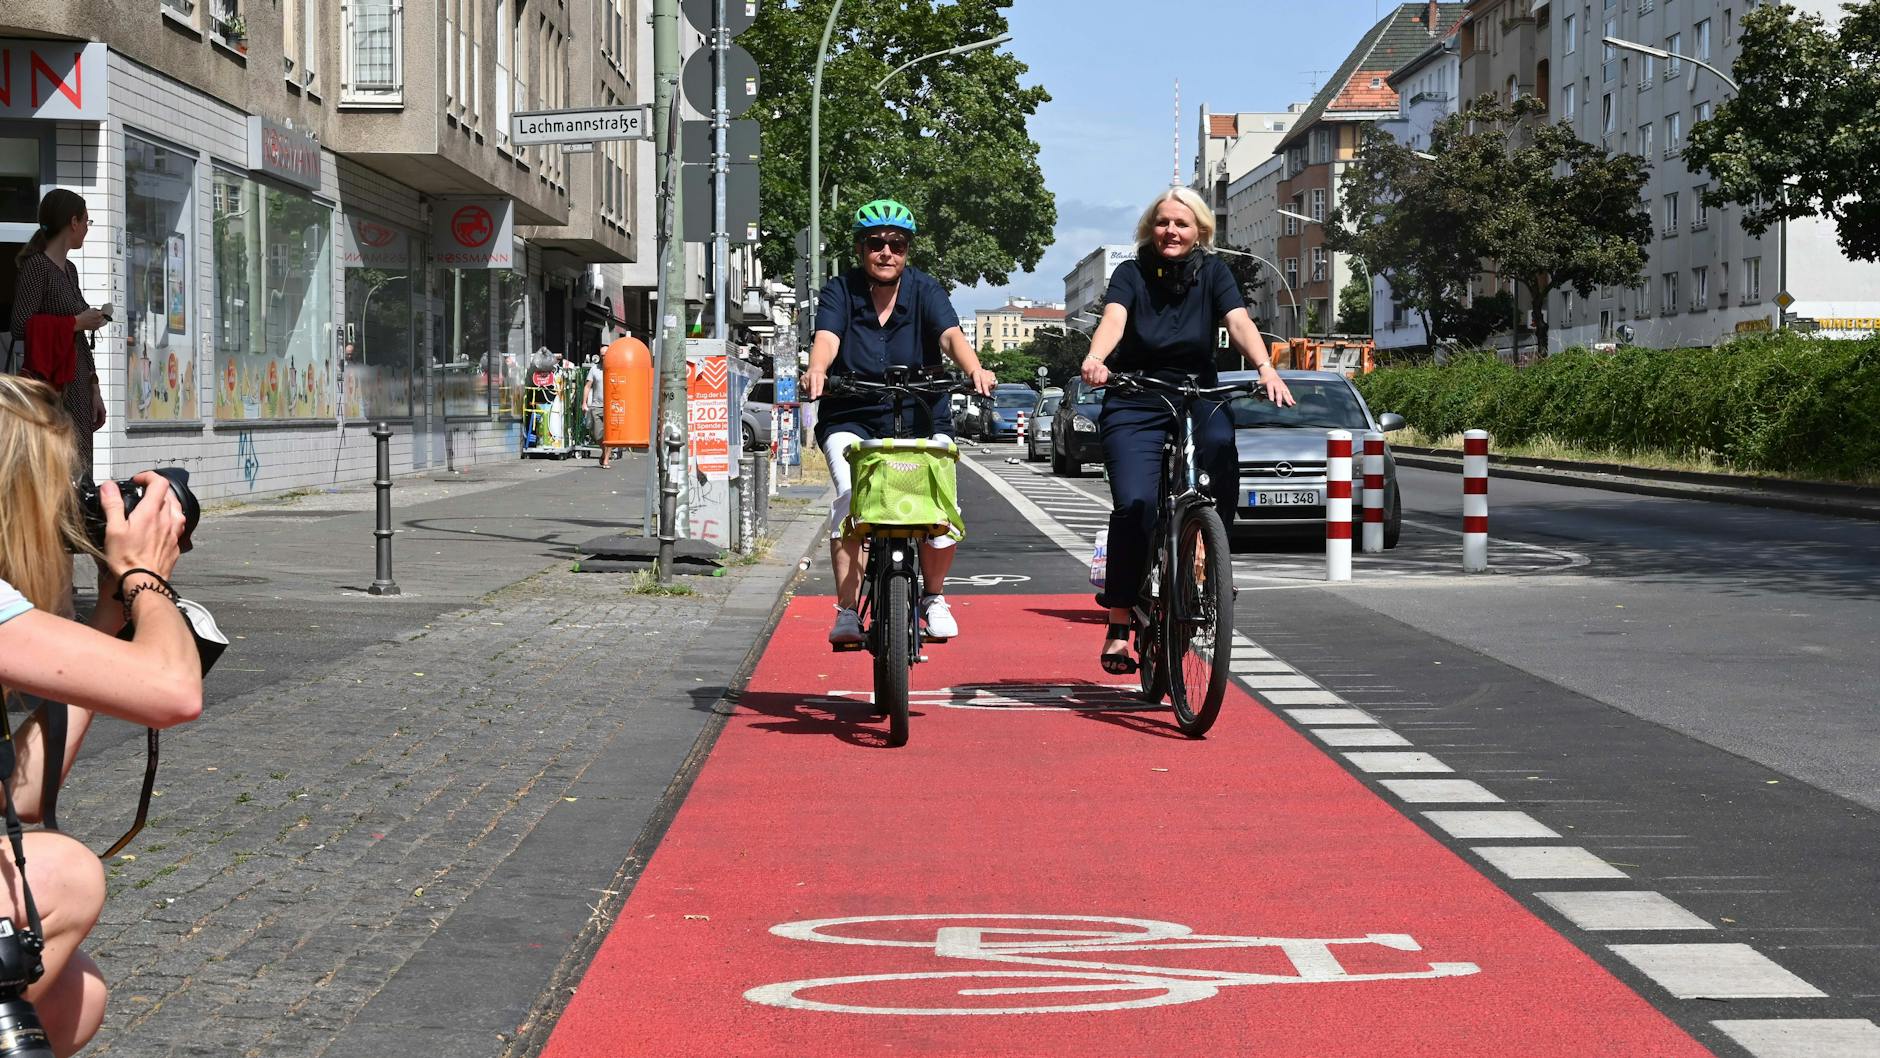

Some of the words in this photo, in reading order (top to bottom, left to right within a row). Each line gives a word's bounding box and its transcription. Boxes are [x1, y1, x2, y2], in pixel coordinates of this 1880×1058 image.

[0, 48, 81, 109] N
[520, 114, 638, 134] Lachmannstraße
[437, 252, 508, 264] ROSSMANN
[1260, 493, 1267, 504] B
[1275, 493, 1289, 504] UI
[1292, 492, 1314, 504] 348
